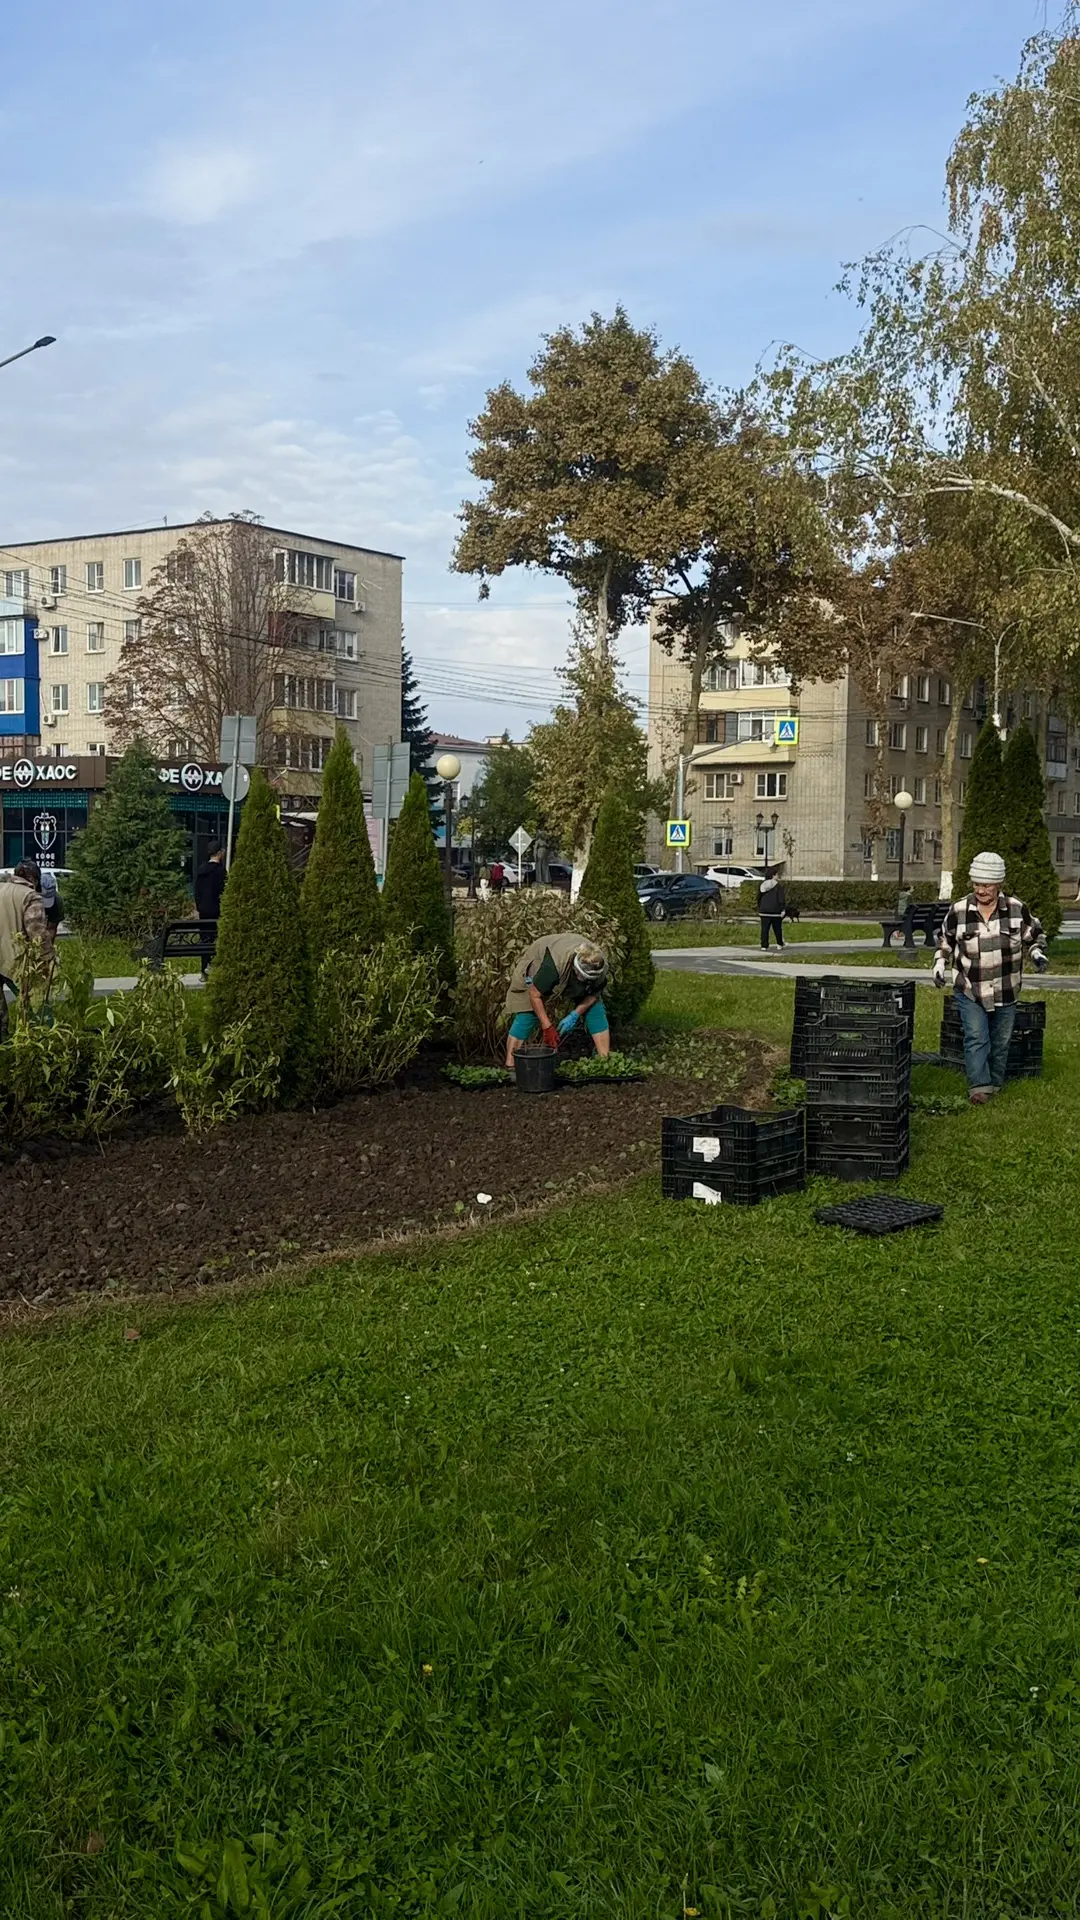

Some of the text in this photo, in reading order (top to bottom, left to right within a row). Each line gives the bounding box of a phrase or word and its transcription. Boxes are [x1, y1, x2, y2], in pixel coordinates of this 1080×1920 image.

[0, 764, 78, 780] Е ХАОС
[158, 768, 223, 785] ФЕ ХА
[35, 852, 56, 860] КОФЕ
